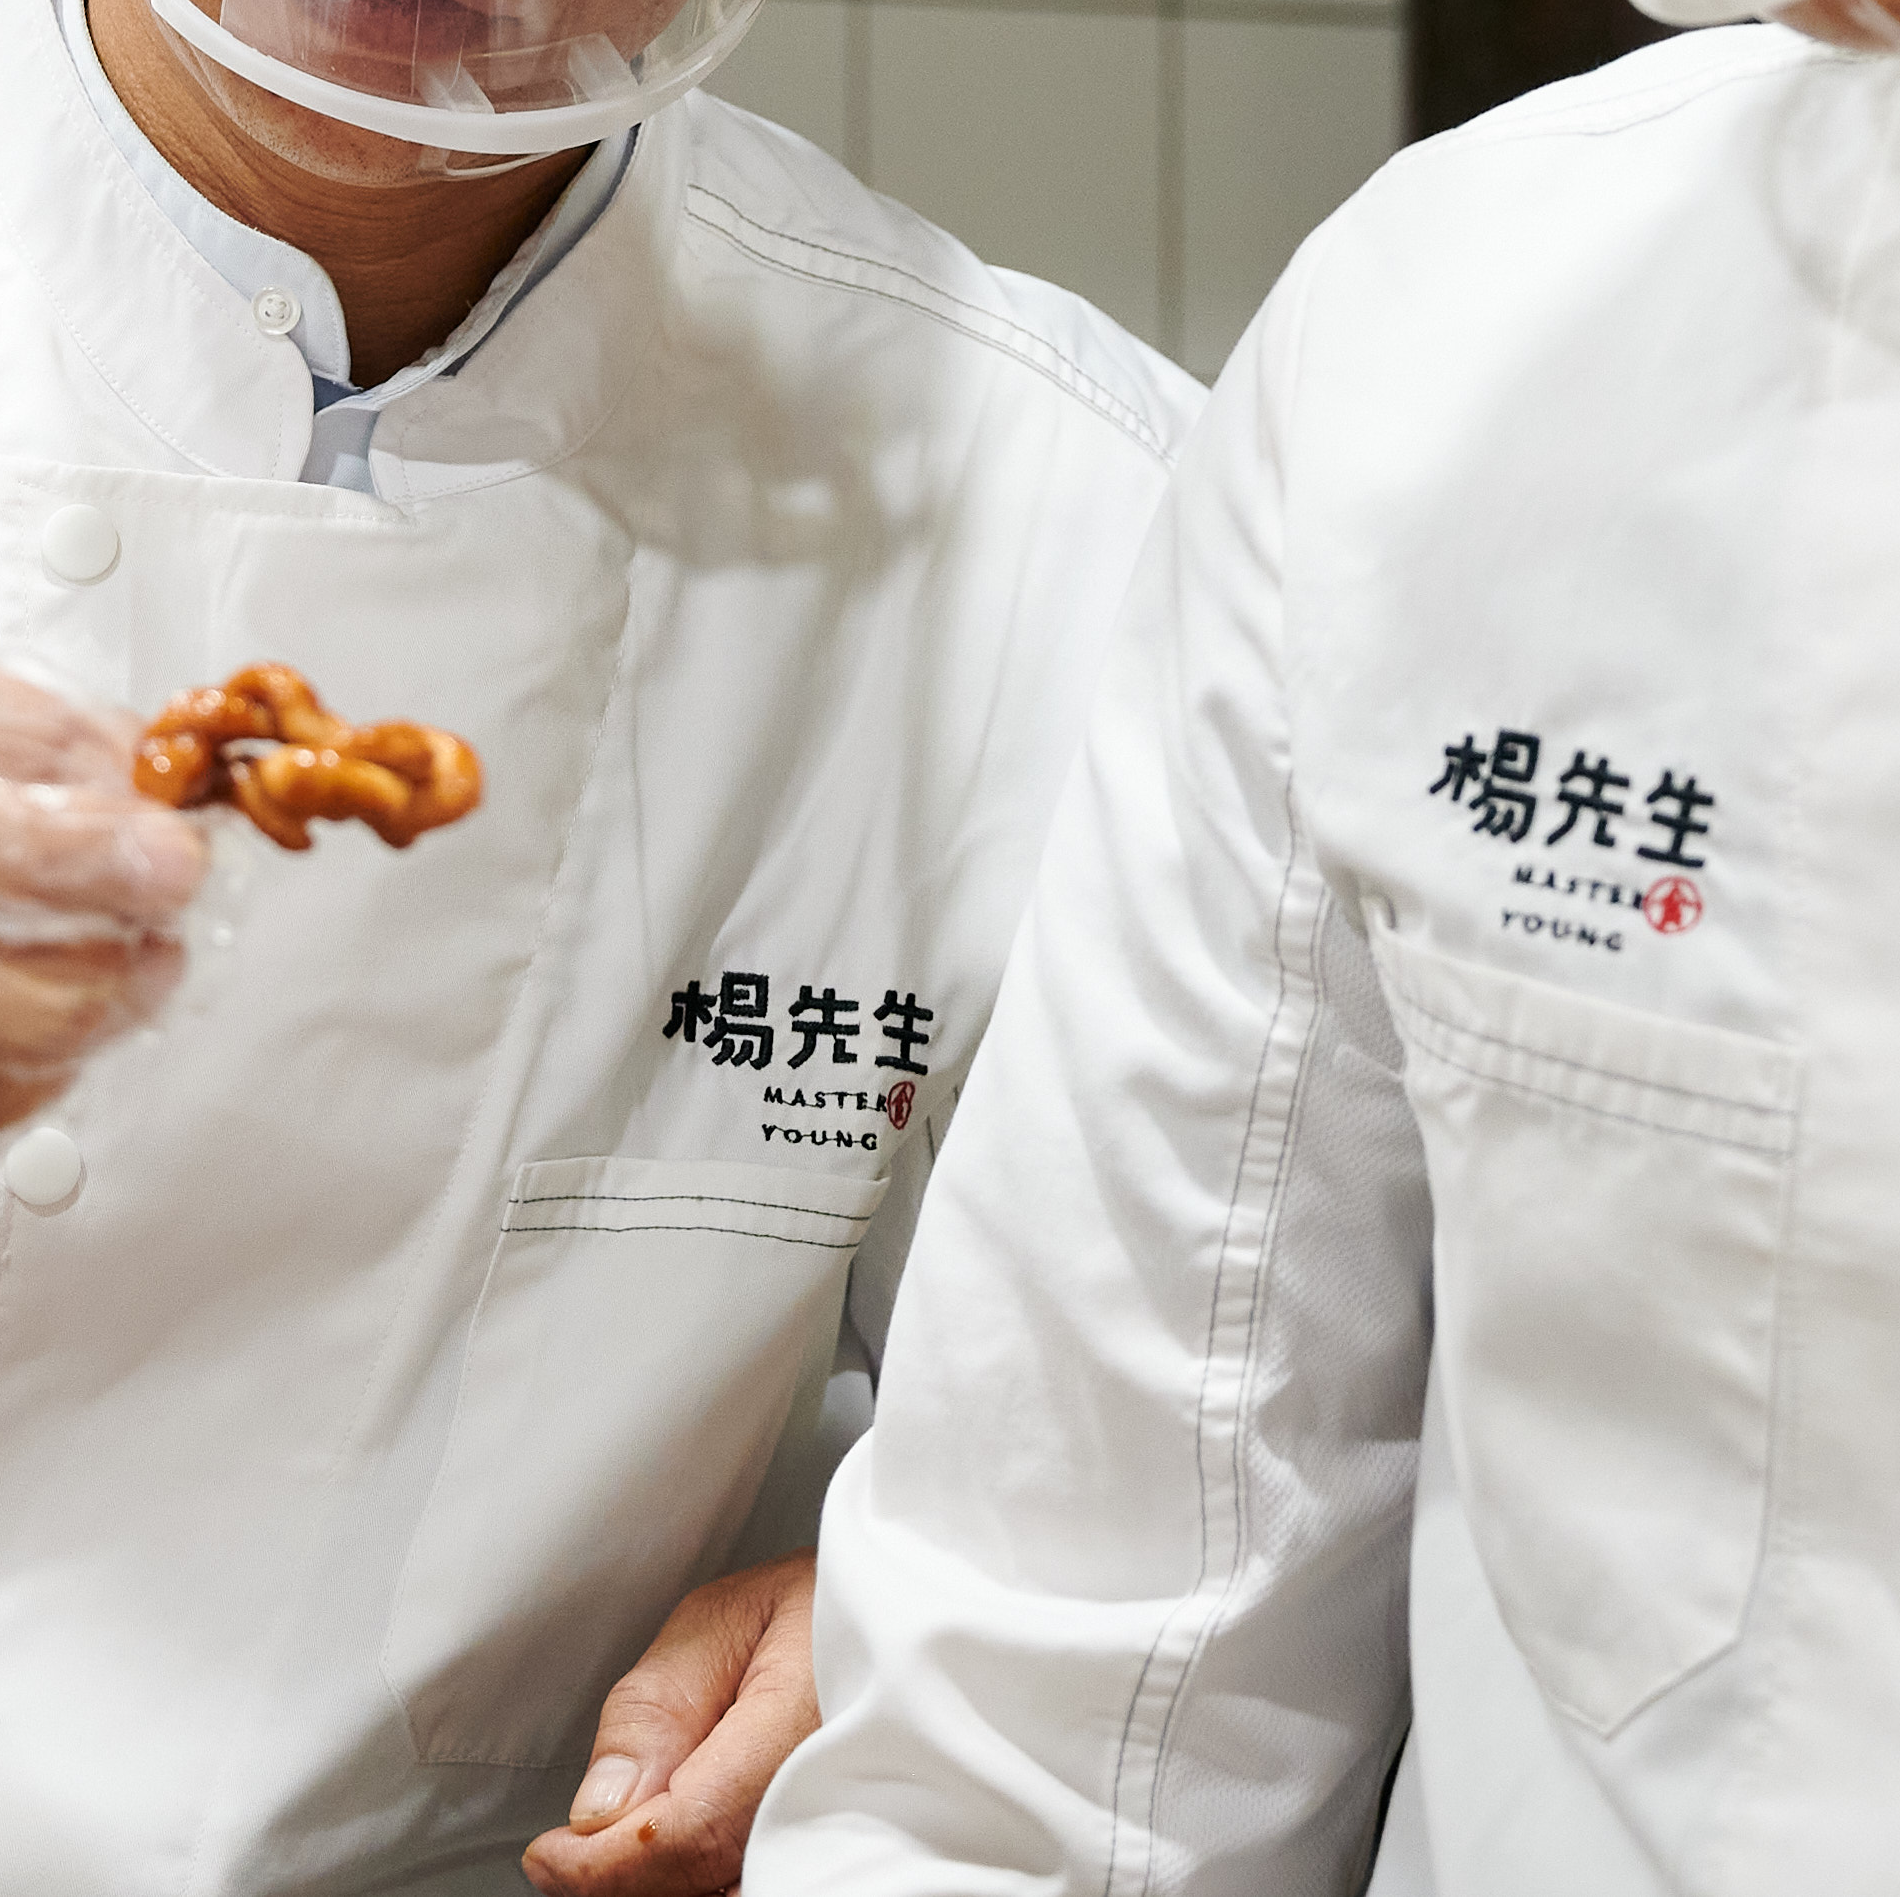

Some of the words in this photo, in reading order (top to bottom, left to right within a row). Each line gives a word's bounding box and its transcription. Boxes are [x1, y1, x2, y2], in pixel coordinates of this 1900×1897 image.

[1429, 728, 1715, 869] 楊先生
[1513, 866, 1644, 911] MASTER
[1502, 908, 1623, 952] YOUNG
[662, 971, 935, 1076] 楊先生
[763, 1085, 889, 1113] MASTER
[761, 1123, 879, 1151] YOUNG
